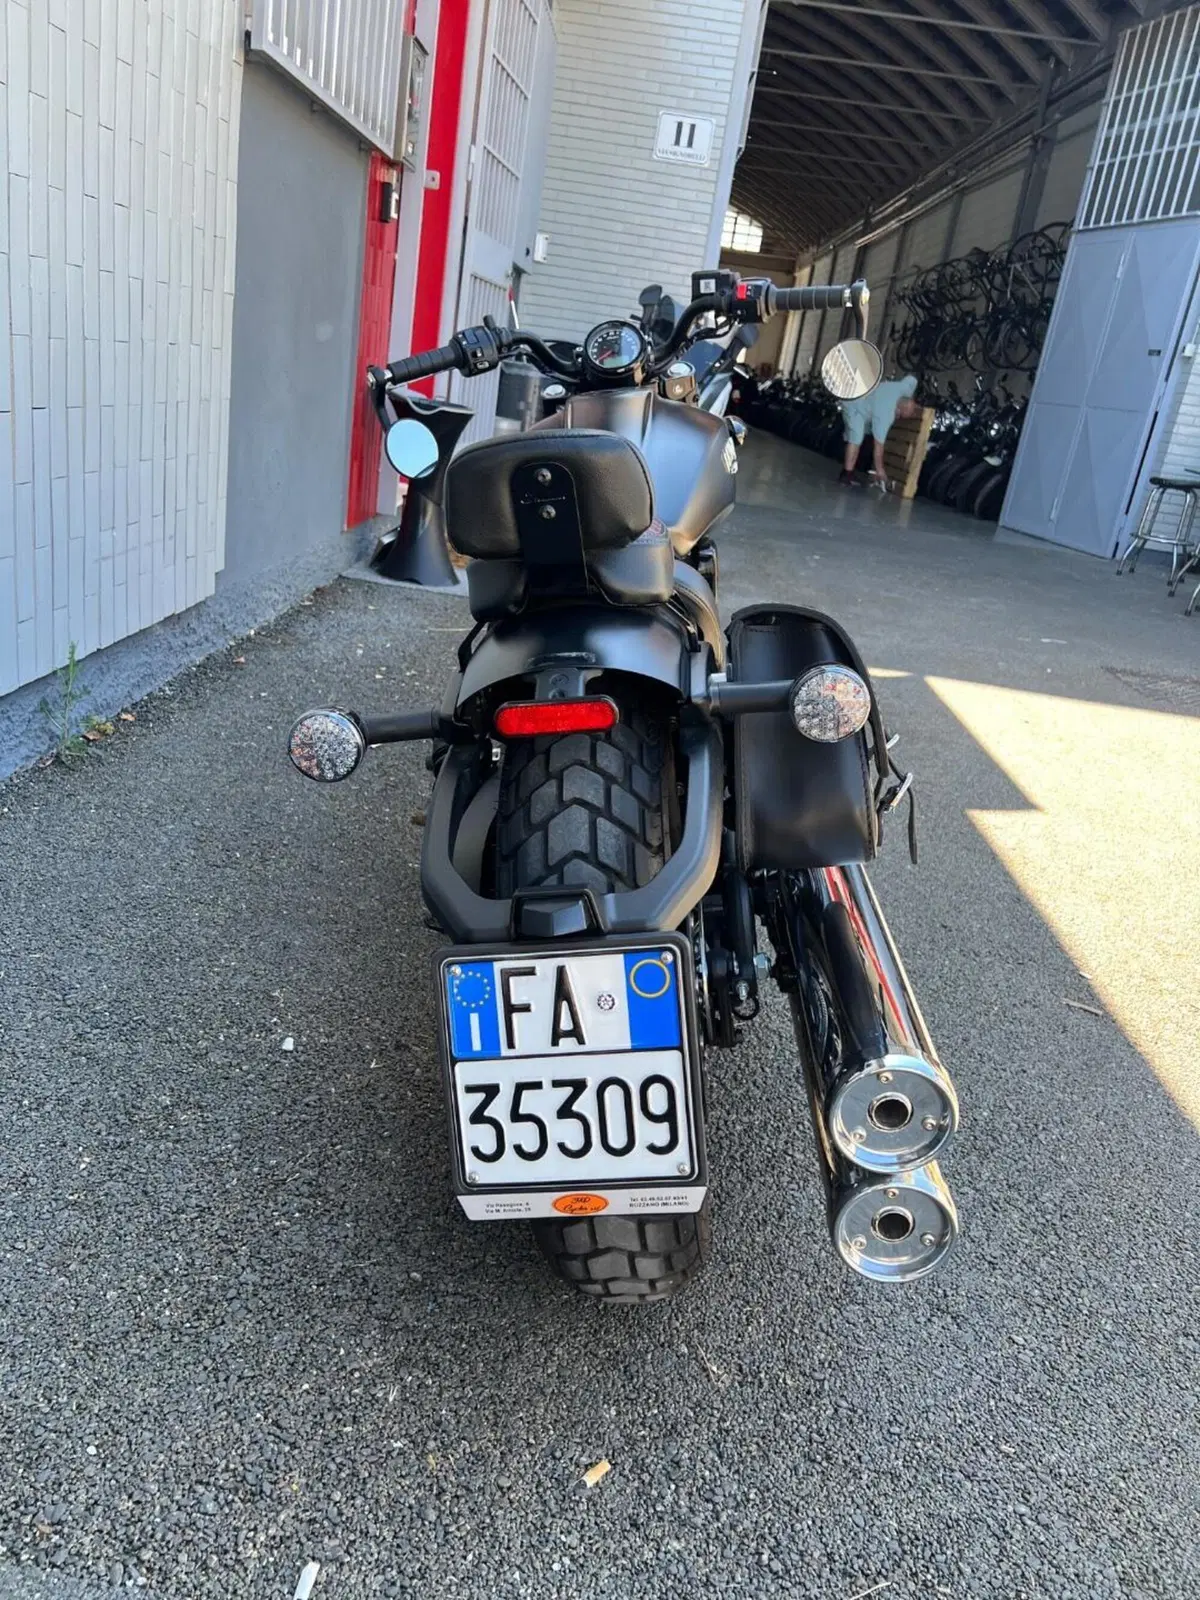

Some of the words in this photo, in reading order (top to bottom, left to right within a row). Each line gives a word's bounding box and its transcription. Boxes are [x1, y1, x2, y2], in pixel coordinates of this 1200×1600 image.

[672, 121, 696, 148] 11
[500, 965, 587, 1050] FA
[464, 1074, 680, 1163] 35309
